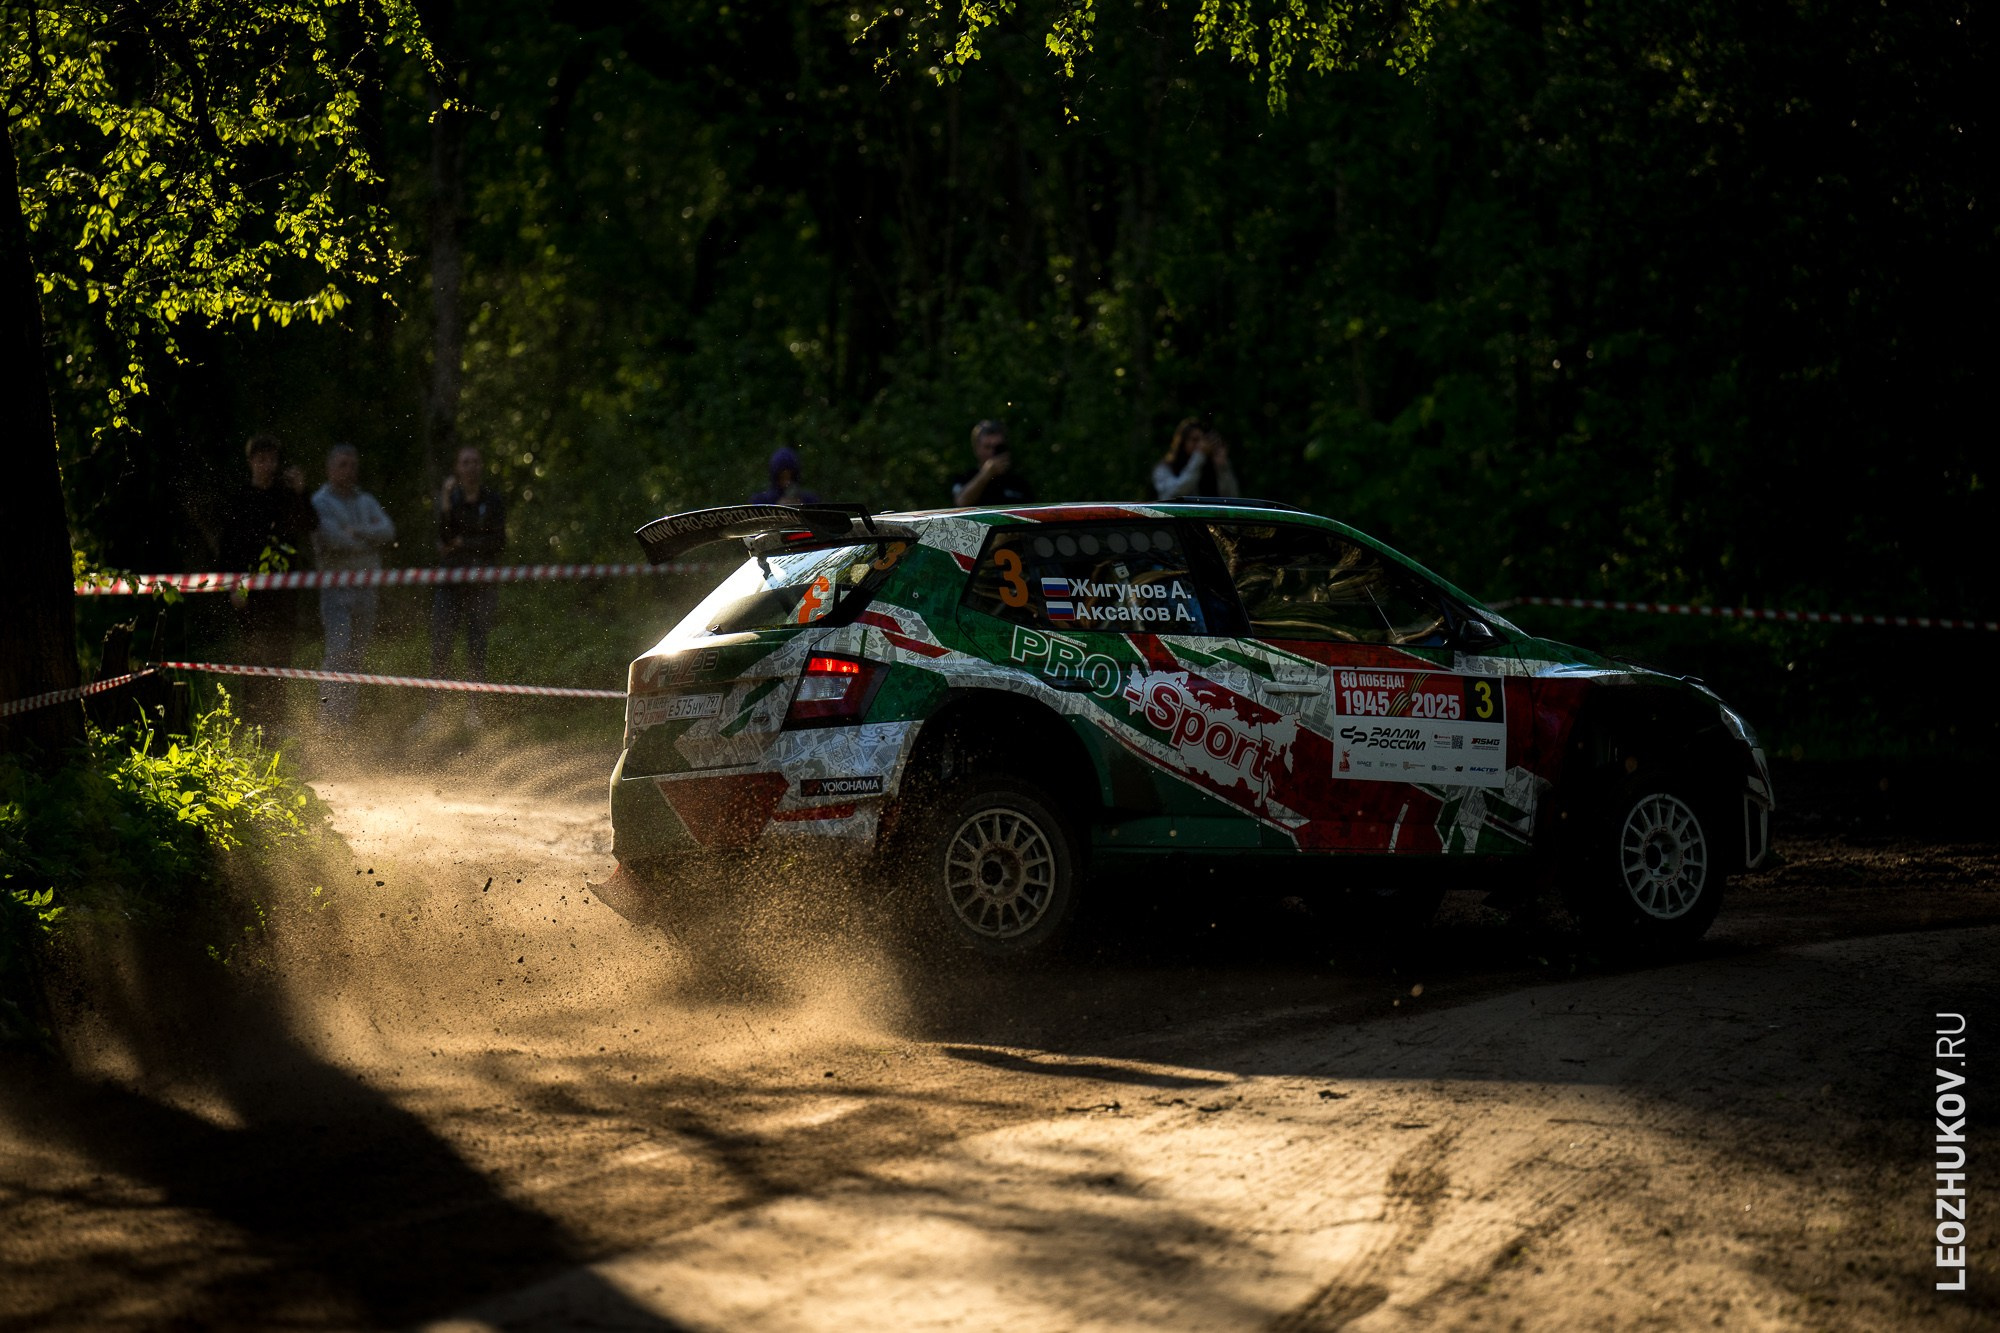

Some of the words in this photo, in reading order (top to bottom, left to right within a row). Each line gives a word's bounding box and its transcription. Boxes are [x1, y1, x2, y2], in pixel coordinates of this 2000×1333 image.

[994, 548, 1030, 608] 3
[1068, 578, 1167, 603] Жигунов
[1171, 580, 1193, 600] А.
[1076, 602, 1171, 622] Аксаков
[1175, 603, 1197, 622] А.
[1340, 671, 1358, 688] 80
[1359, 673, 1405, 690] ПОБЕДА!
[1342, 690, 1390, 716] 1945
[1411, 692, 1461, 719] 2025
[1474, 680, 1494, 719] 3
[1371, 727, 1420, 739] РАЛЛИ
[1367, 738, 1426, 751] РОССИИ
[822, 779, 880, 792] YOKOHAMA
